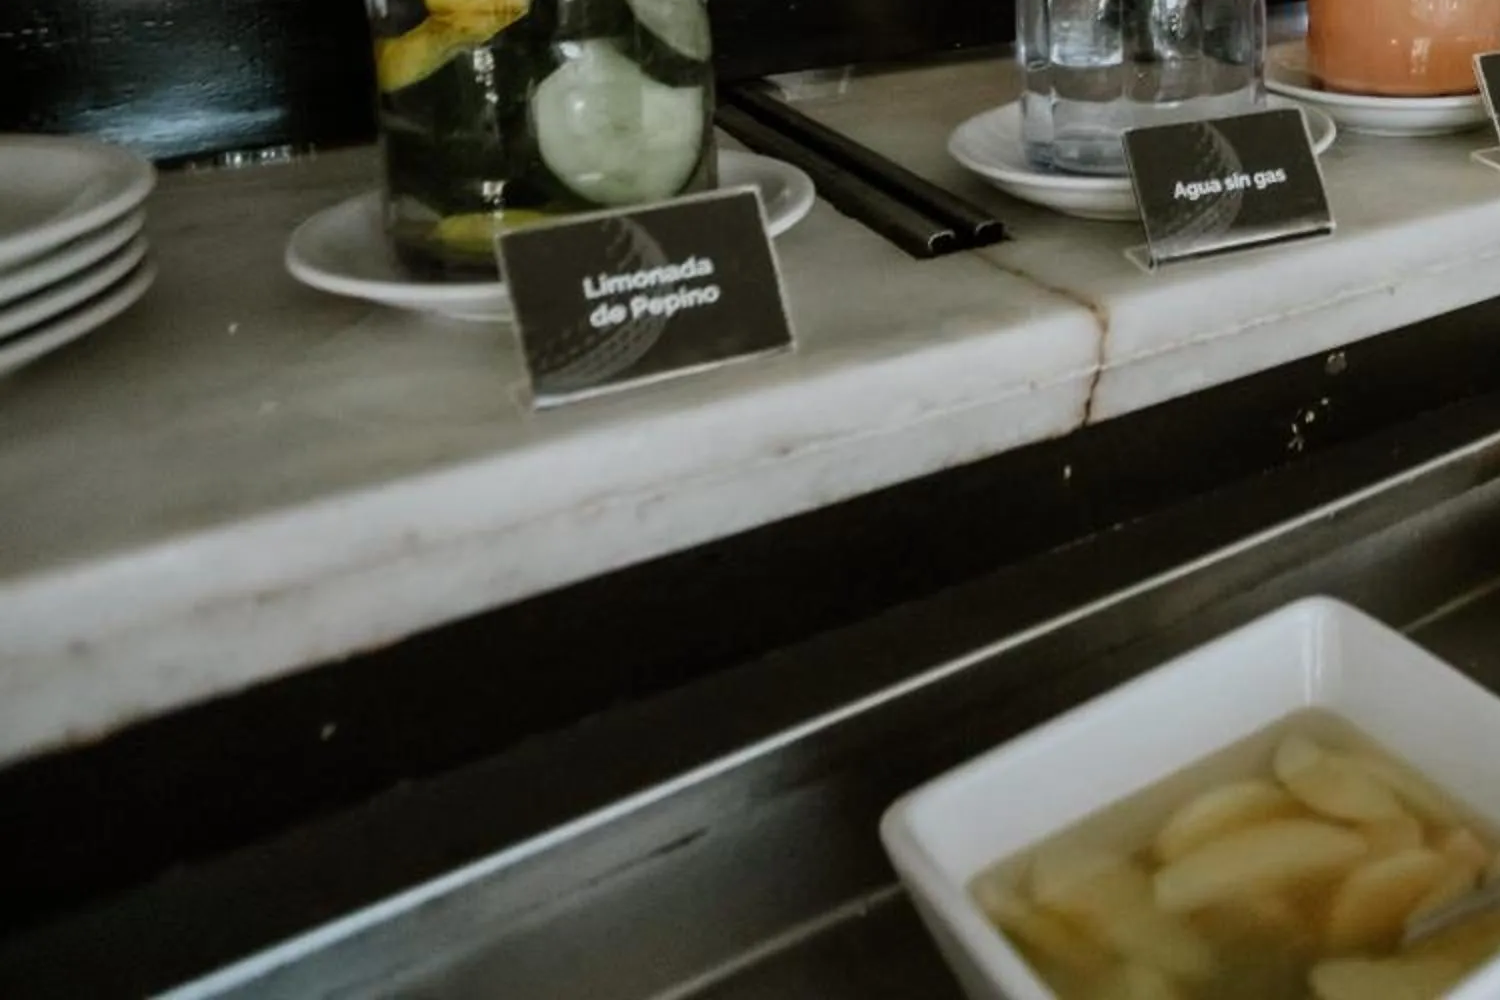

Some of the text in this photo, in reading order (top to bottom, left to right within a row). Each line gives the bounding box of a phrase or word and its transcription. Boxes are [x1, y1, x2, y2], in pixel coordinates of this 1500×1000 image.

[1173, 167, 1287, 200] Agua sin gas
[582, 254, 715, 300] Limonada
[589, 284, 721, 328] de Pepino
